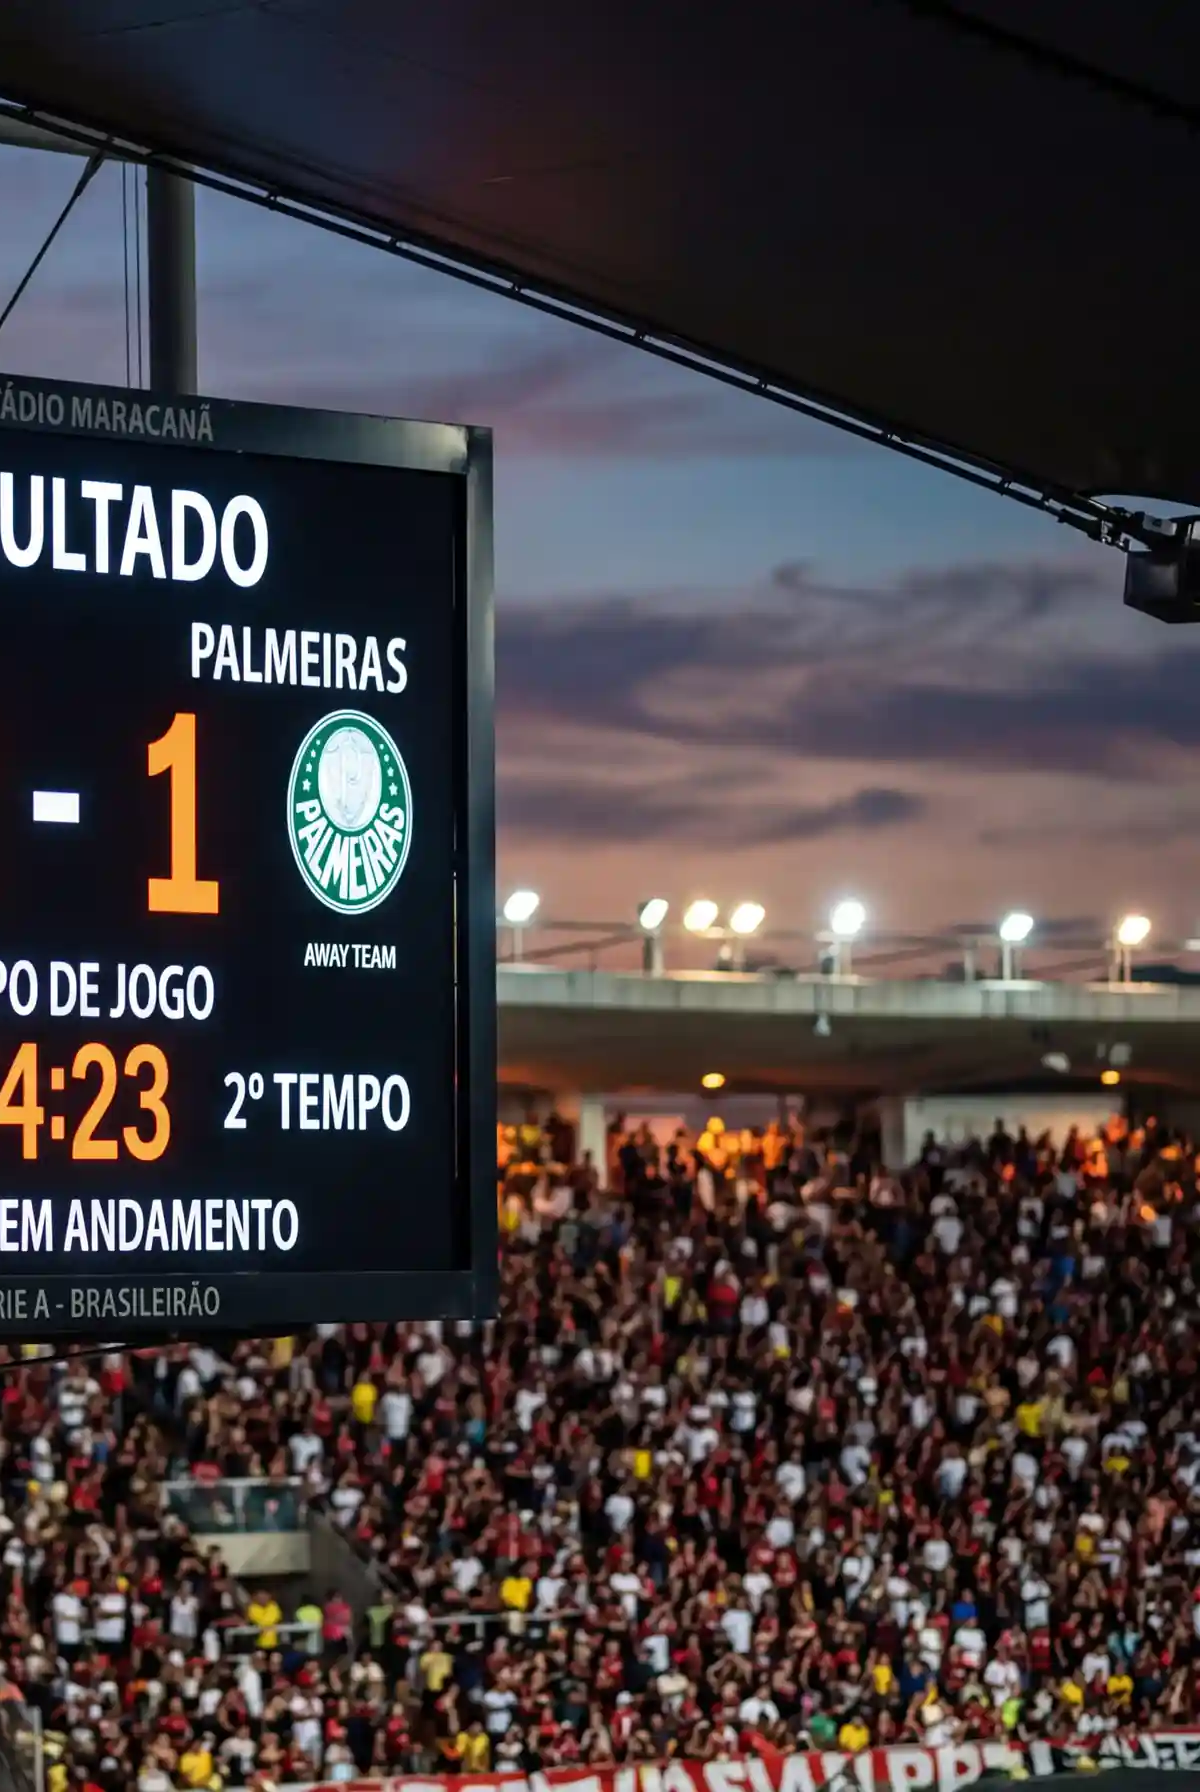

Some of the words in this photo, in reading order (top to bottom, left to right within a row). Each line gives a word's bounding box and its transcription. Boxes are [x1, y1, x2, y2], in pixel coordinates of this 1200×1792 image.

[71, 396, 214, 441] MARACANÃ
[190, 621, 408, 694] PALMEIRAS
[147, 713, 220, 915] 1
[295, 799, 405, 900] PALMEIRAS
[304, 942, 350, 968] AWAY
[351, 943, 397, 970] TEAM
[49, 961, 101, 1018] DE
[109, 963, 215, 1021] JOGO
[272, 1072, 411, 1132] TEMPO
[63, 1198, 299, 1252] ANDAMENTO
[33, 1289, 50, 1319] A
[71, 1281, 220, 1318] BRASILEIRÃO
